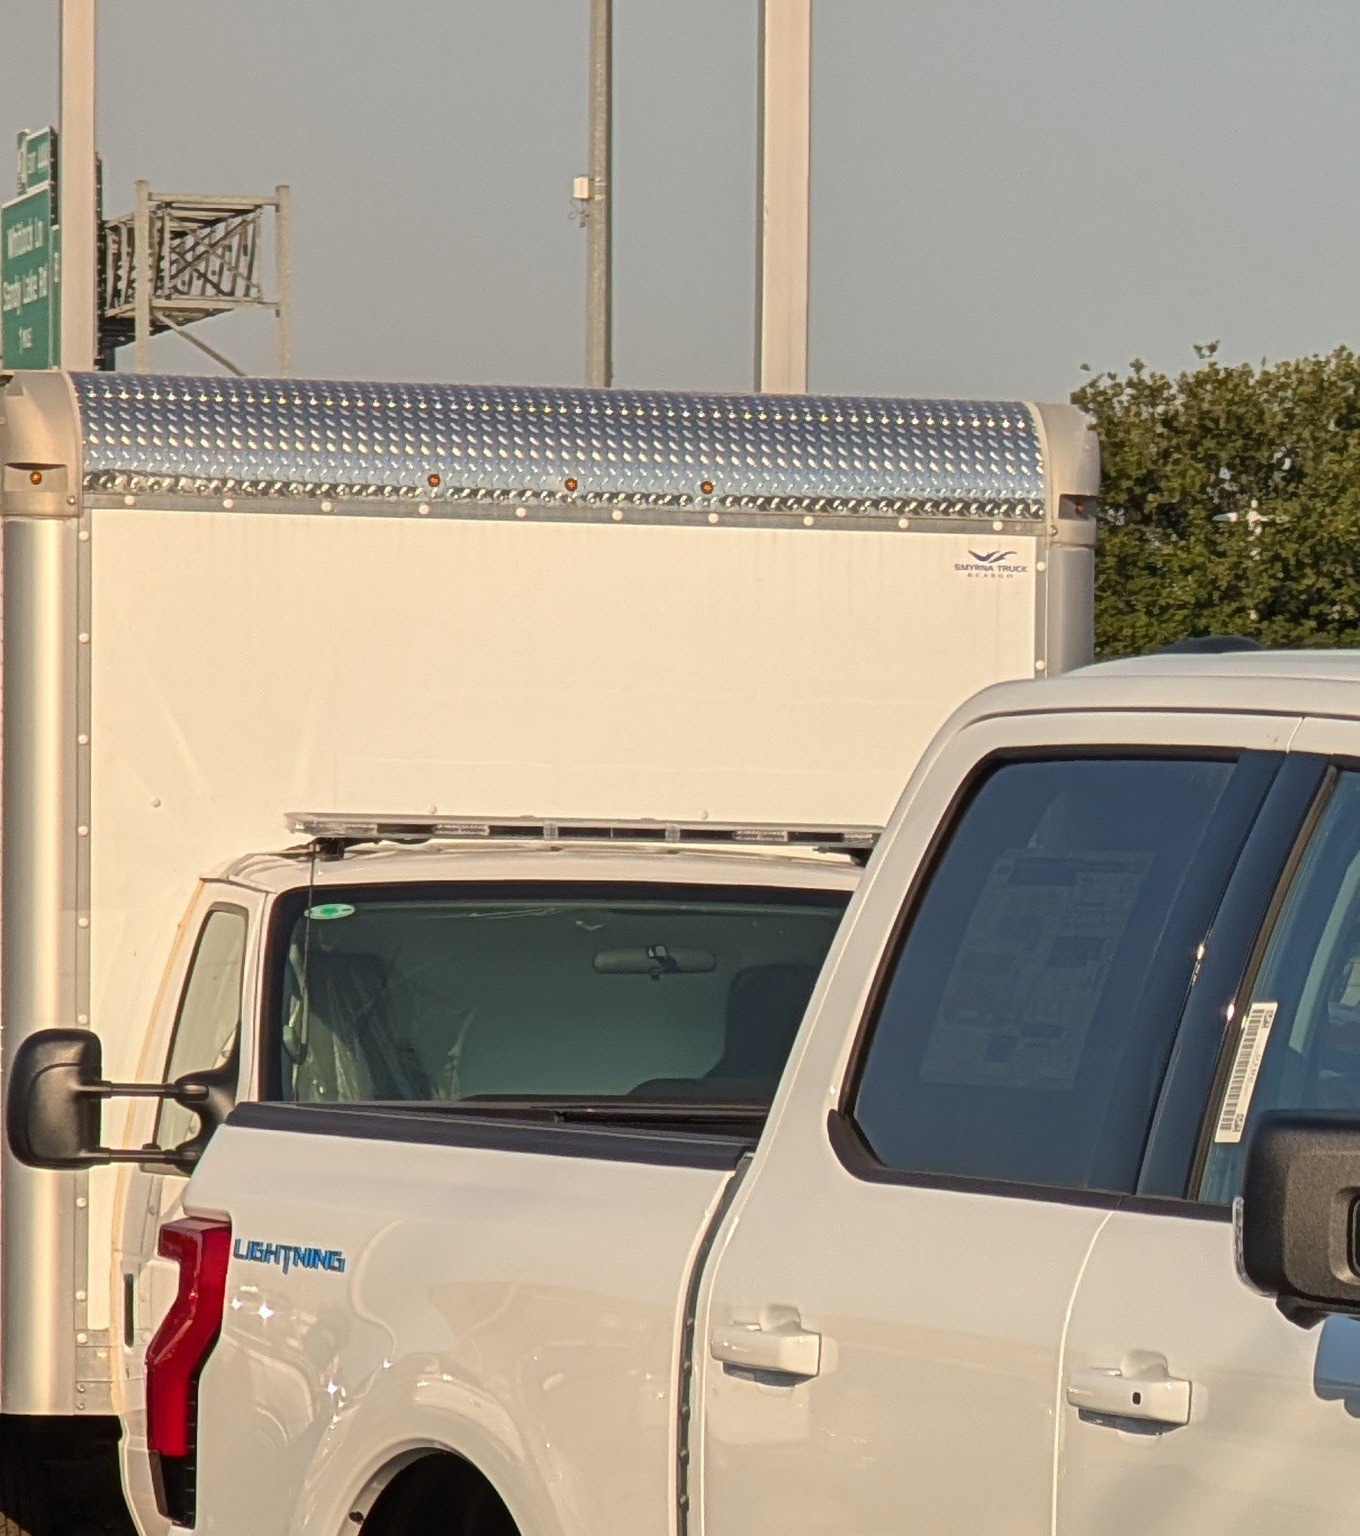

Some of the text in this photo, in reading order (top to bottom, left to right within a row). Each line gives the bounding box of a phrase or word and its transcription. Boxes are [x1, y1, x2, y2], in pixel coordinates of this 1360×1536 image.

[954, 563, 1028, 573] SMYRNA TRUCK
[233, 1238, 346, 1275] LIGHTNING
